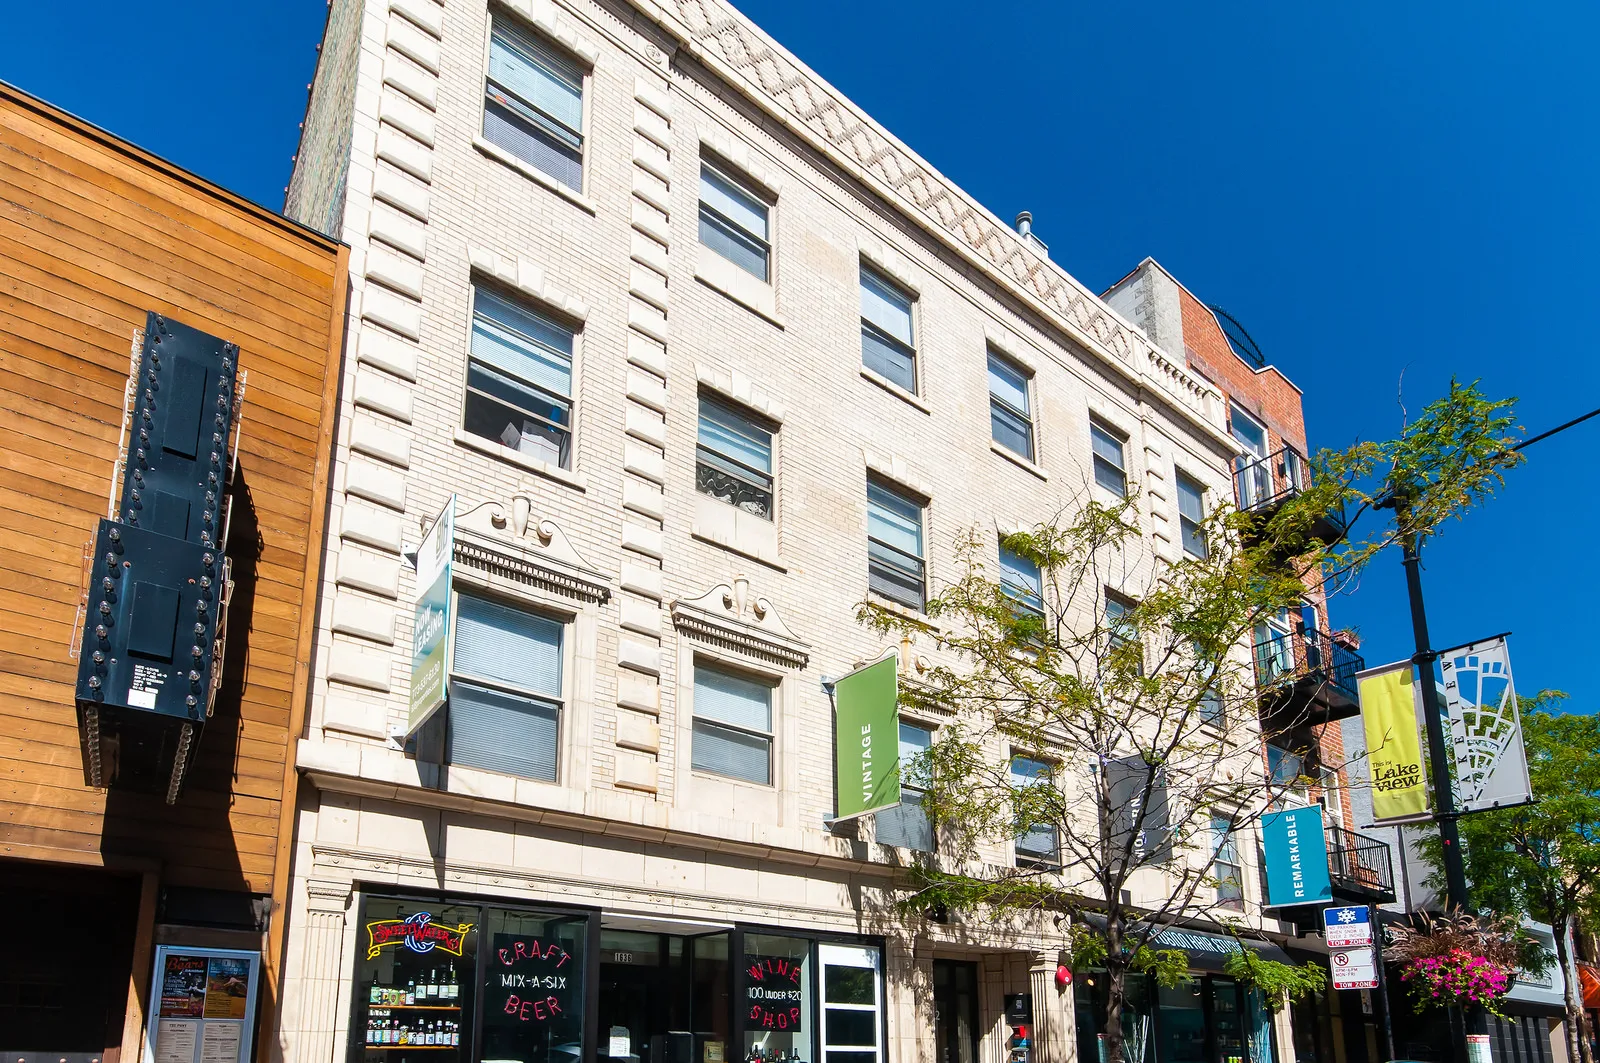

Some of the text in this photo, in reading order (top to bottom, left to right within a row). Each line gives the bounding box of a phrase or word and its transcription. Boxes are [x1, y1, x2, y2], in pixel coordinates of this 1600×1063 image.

[415, 603, 432, 637] NOW
[414, 609, 443, 658] LEASING
[861, 723, 873, 803] VINTAGE
[1372, 763, 1419, 781] Lake
[1374, 774, 1421, 792] view
[1285, 814, 1305, 898] REMARKABLE
[1349, 937, 1370, 945] ZONE
[499, 940, 571, 968] CRAFT
[614, 952, 632, 962] 1636
[501, 973, 566, 989] MIX-A-SIX
[747, 960, 802, 984] WINE
[748, 987, 764, 999] 100
[787, 990, 803, 1001] $20
[504, 994, 562, 1021] BEER
[750, 1005, 799, 1029] SHOP
